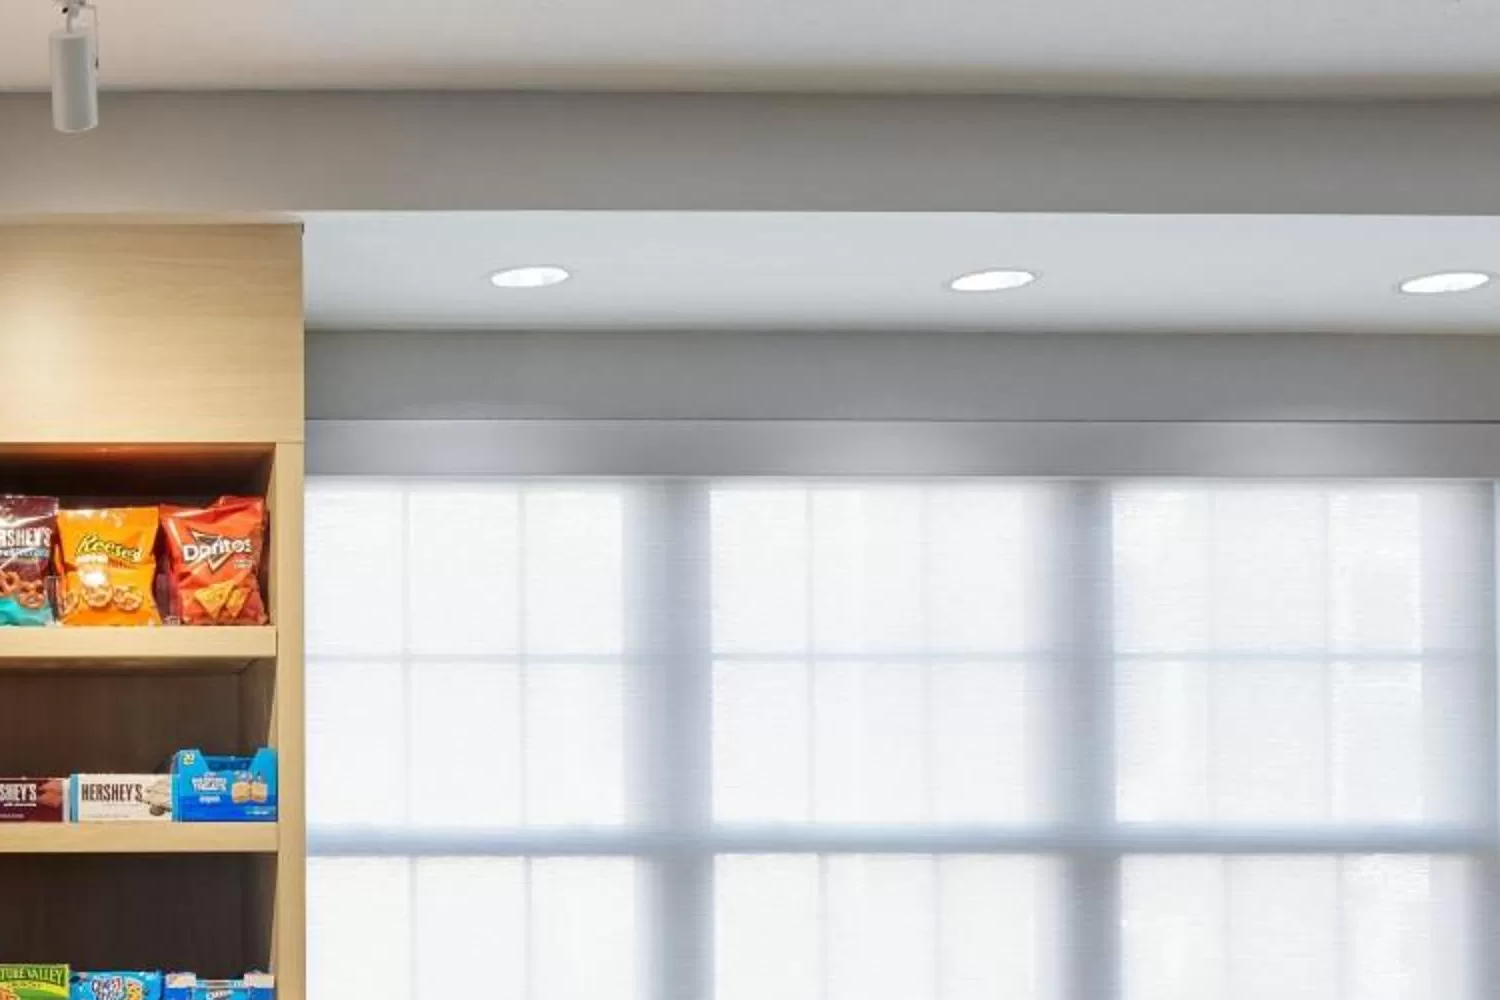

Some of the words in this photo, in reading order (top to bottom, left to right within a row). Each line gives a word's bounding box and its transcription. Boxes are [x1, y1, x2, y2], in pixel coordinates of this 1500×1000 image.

[183, 535, 252, 562] Doritos
[81, 783, 143, 801] HERSHEY'S
[28, 967, 64, 985] VALLEY
